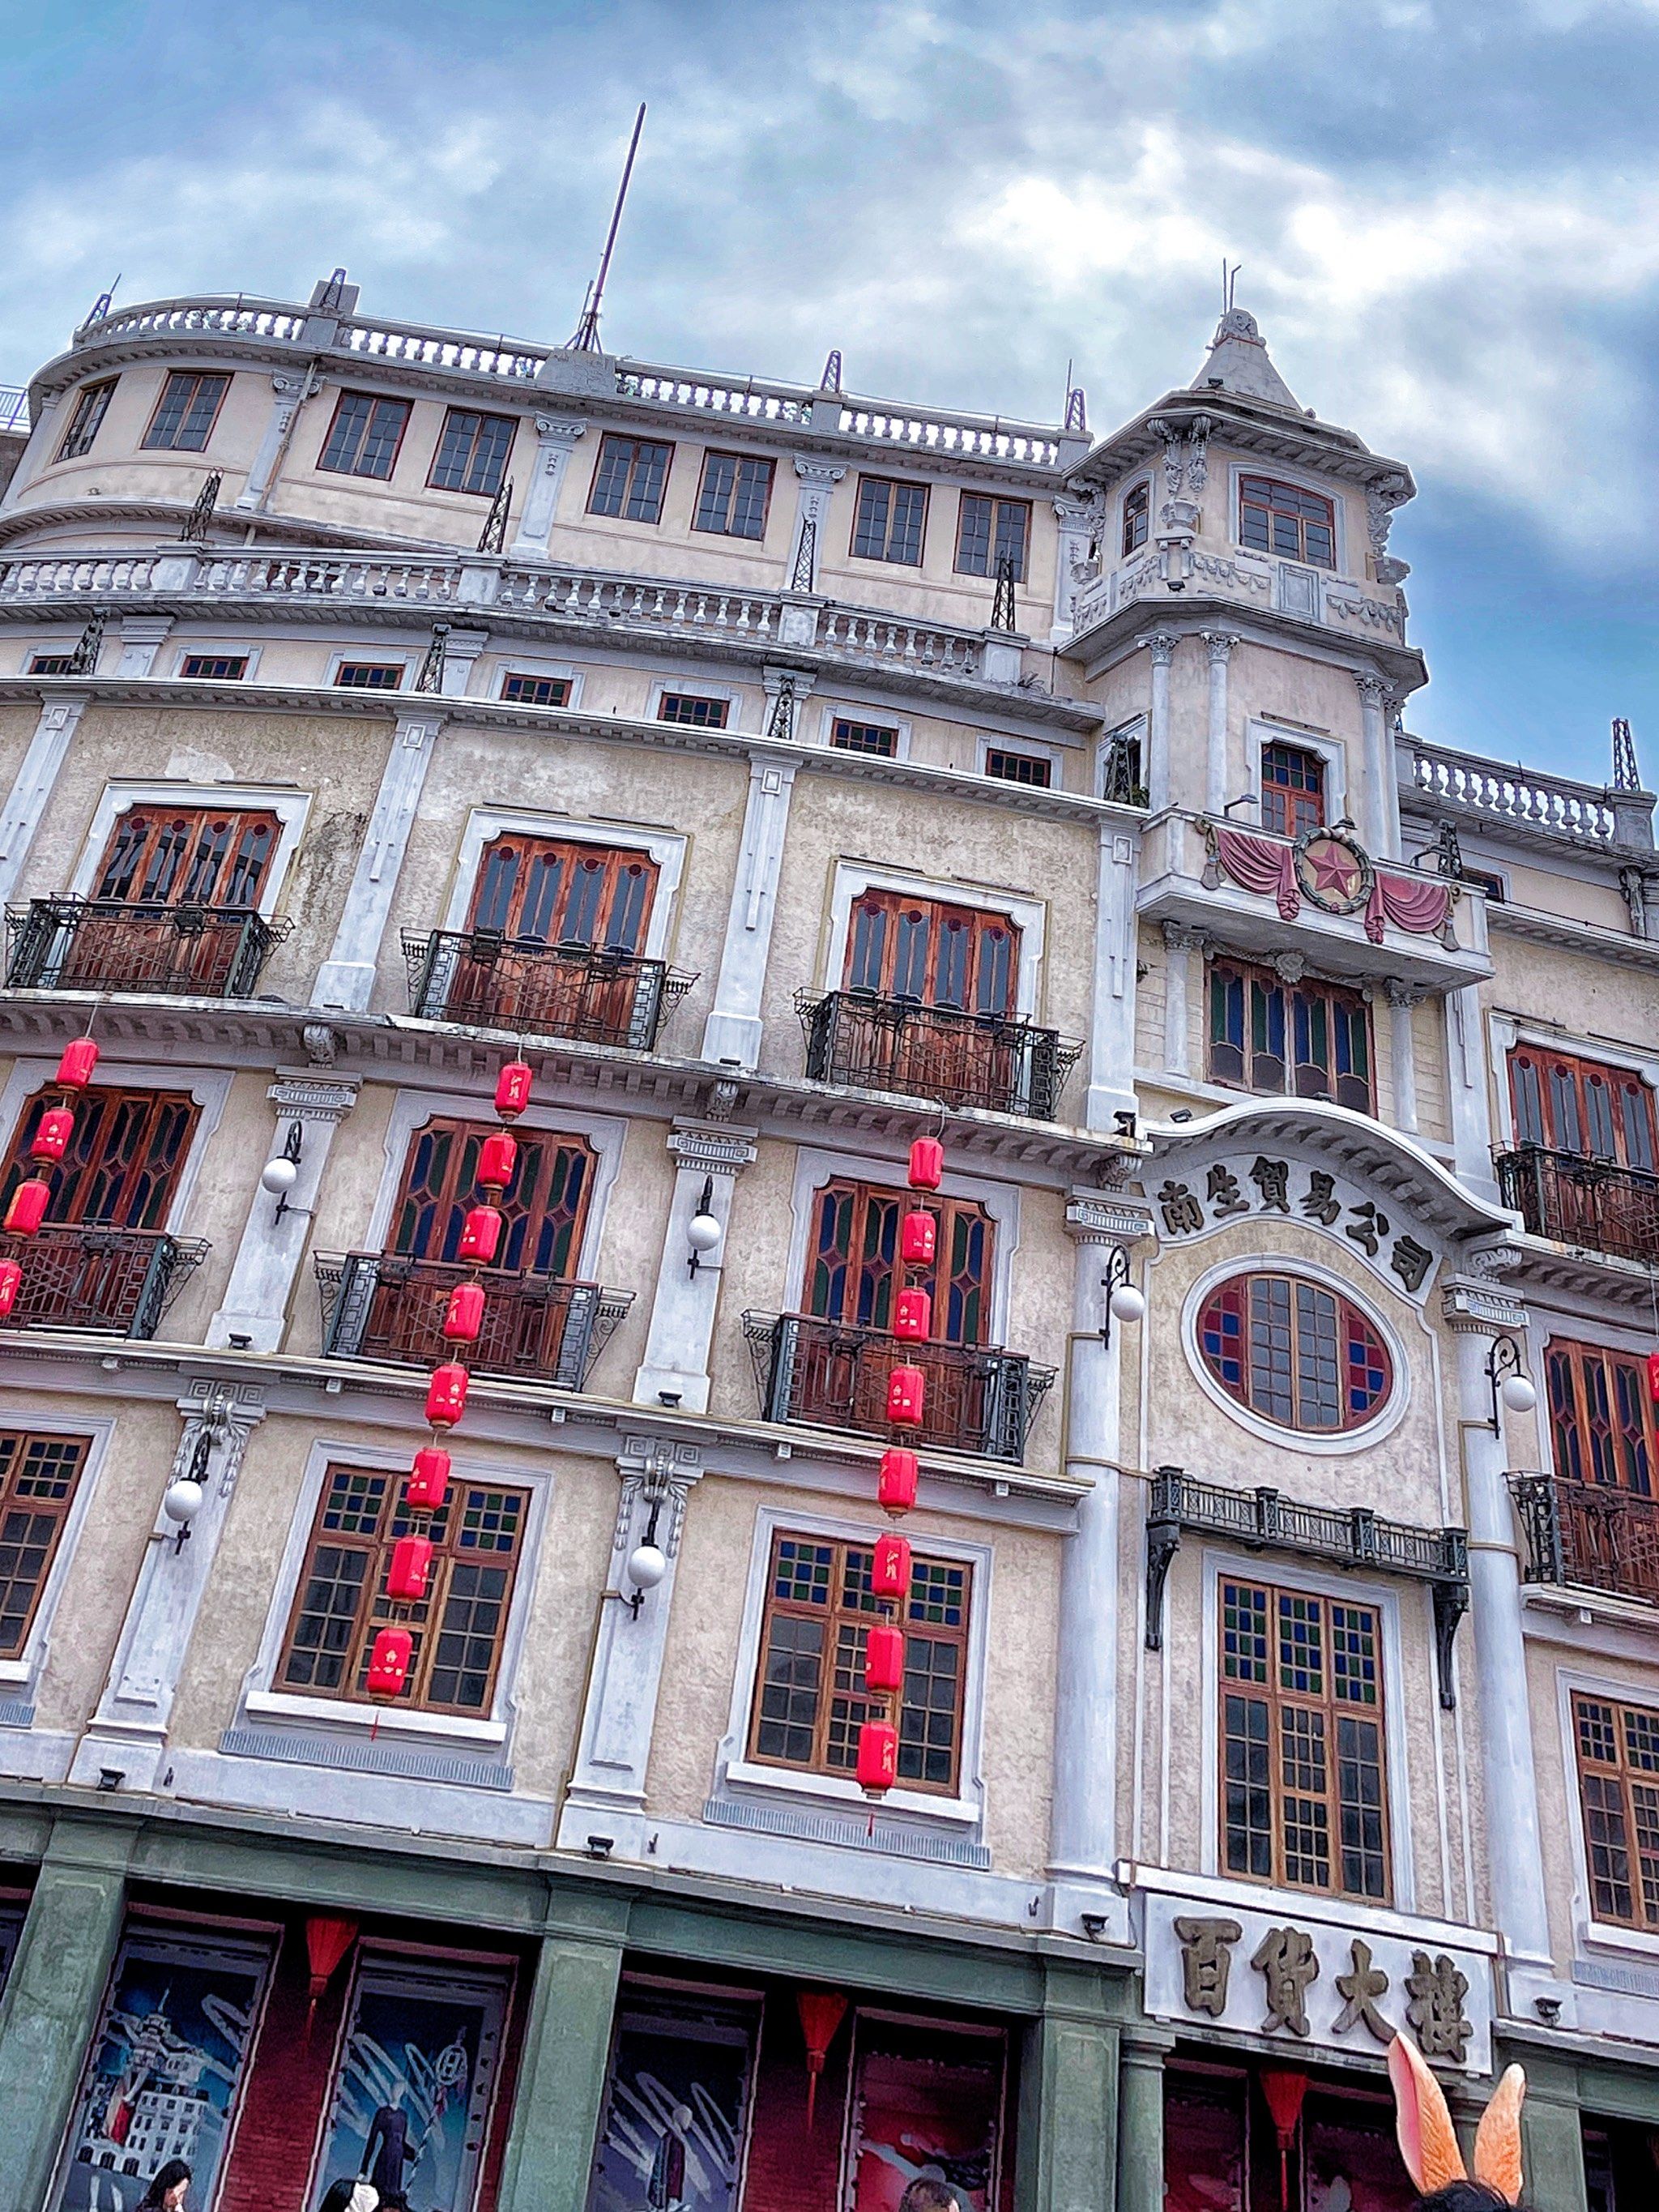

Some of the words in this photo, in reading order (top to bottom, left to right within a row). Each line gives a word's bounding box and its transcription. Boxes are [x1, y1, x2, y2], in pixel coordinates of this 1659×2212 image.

[1158, 1155, 1434, 1293] 南生貿易公司
[1172, 1915, 1474, 2064] 百貨大樓
